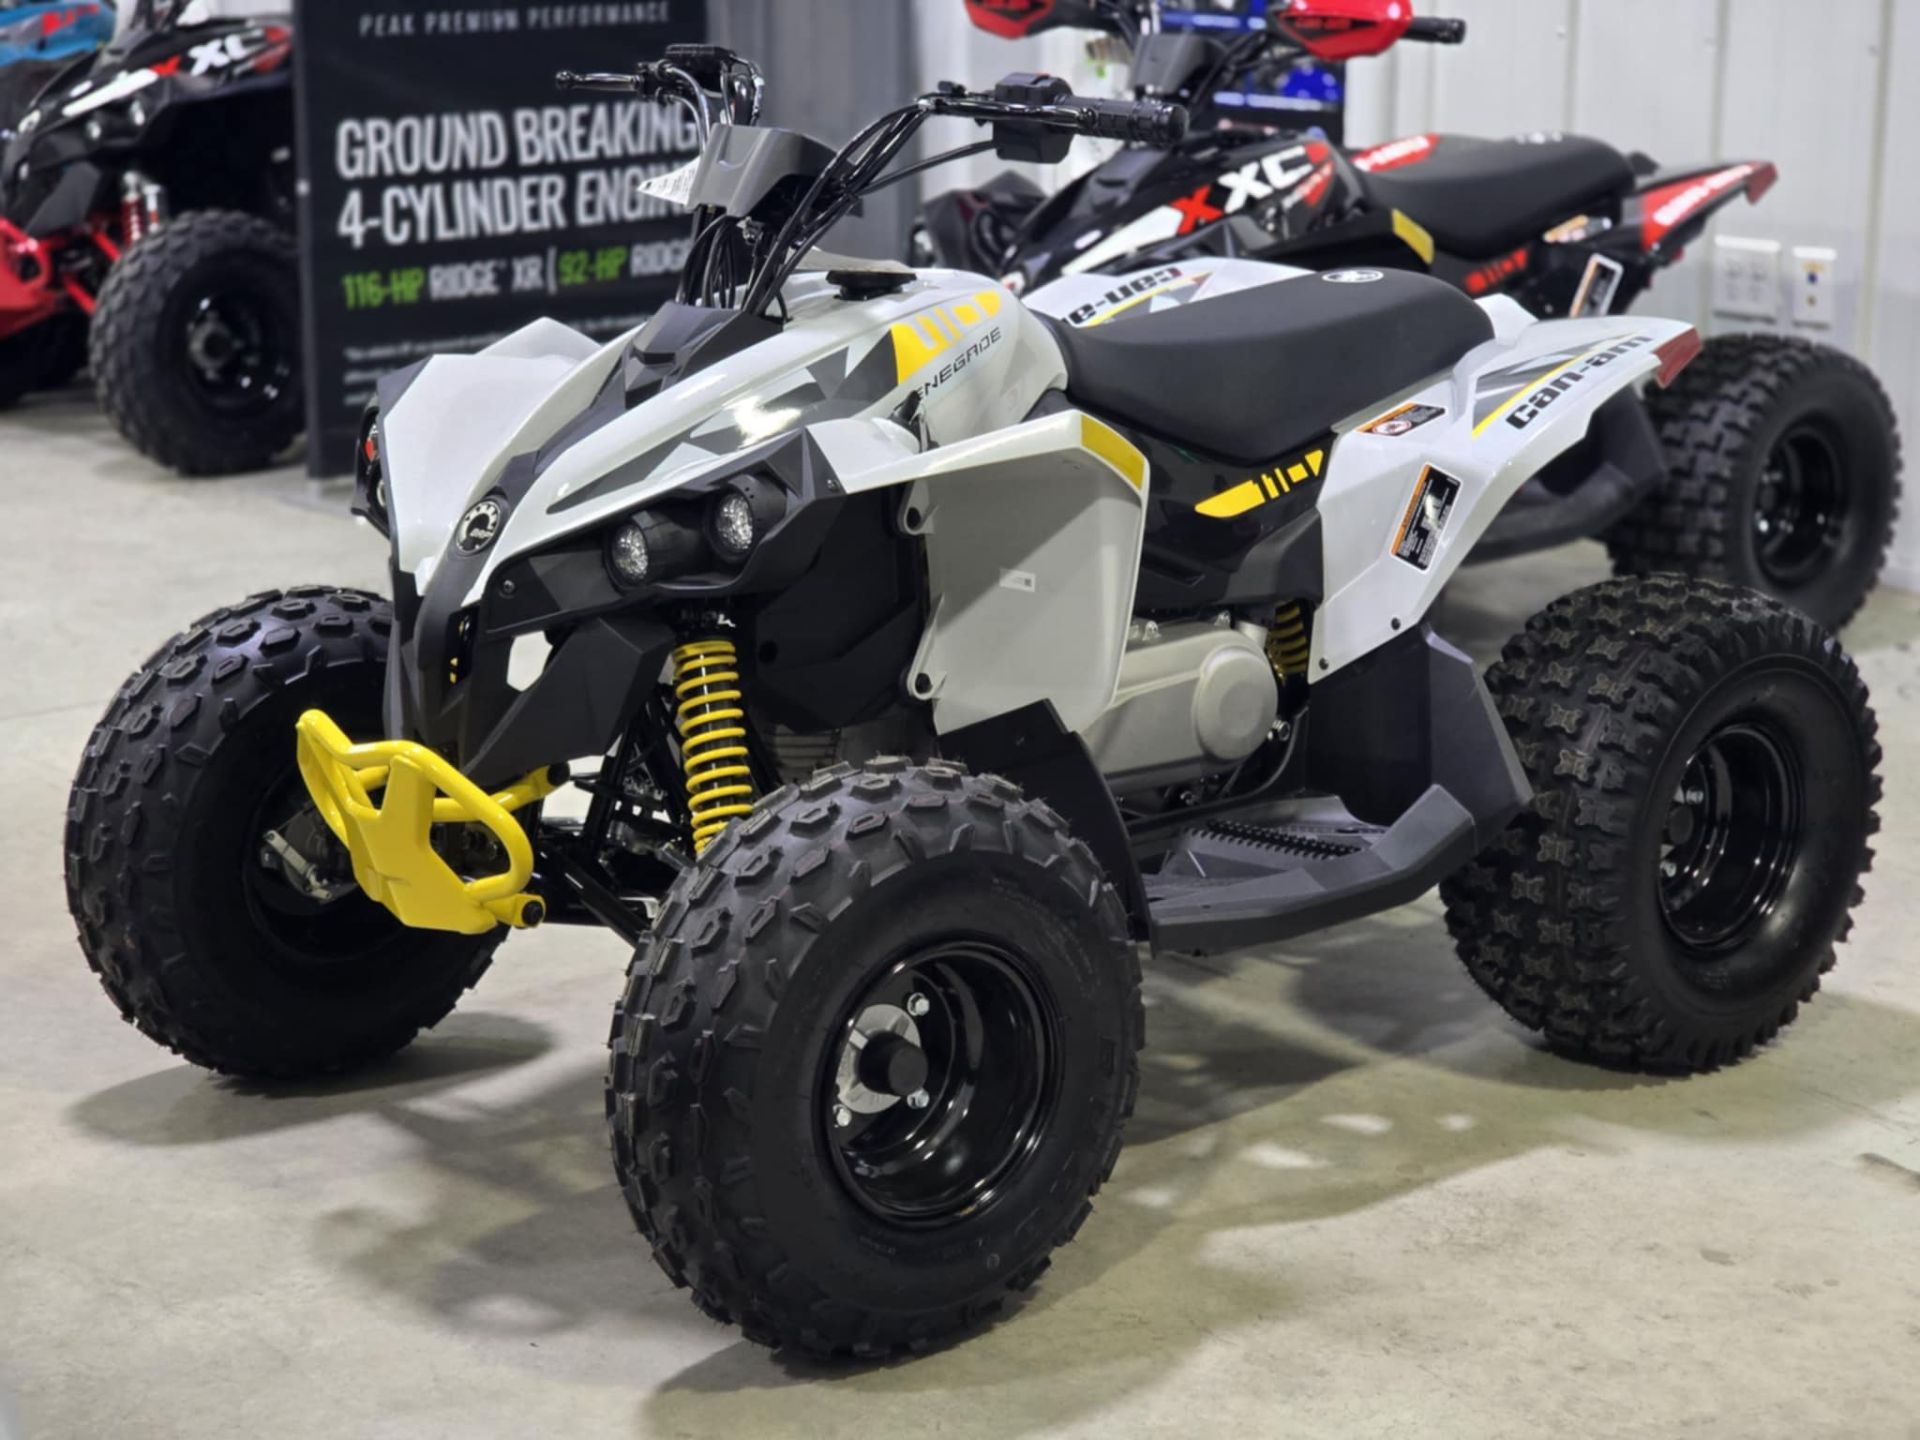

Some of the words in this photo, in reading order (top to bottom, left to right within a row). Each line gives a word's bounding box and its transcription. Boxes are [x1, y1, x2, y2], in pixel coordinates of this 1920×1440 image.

[359, 16, 415, 37] PEAK
[425, 10, 519, 32] PREMIUM
[528, 3, 670, 27] PERFORMANCE
[337, 113, 507, 178] GROUND
[515, 101, 697, 165] BREAKING
[338, 177, 565, 247] 4-CYLINDER
[577, 163, 690, 226] ENGI
[343, 268, 425, 309] 116-HP
[430, 262, 501, 300] RIDGE
[512, 255, 545, 291] XR
[893, 326, 1002, 412] NEGADE
[1506, 335, 1653, 430] can-am
